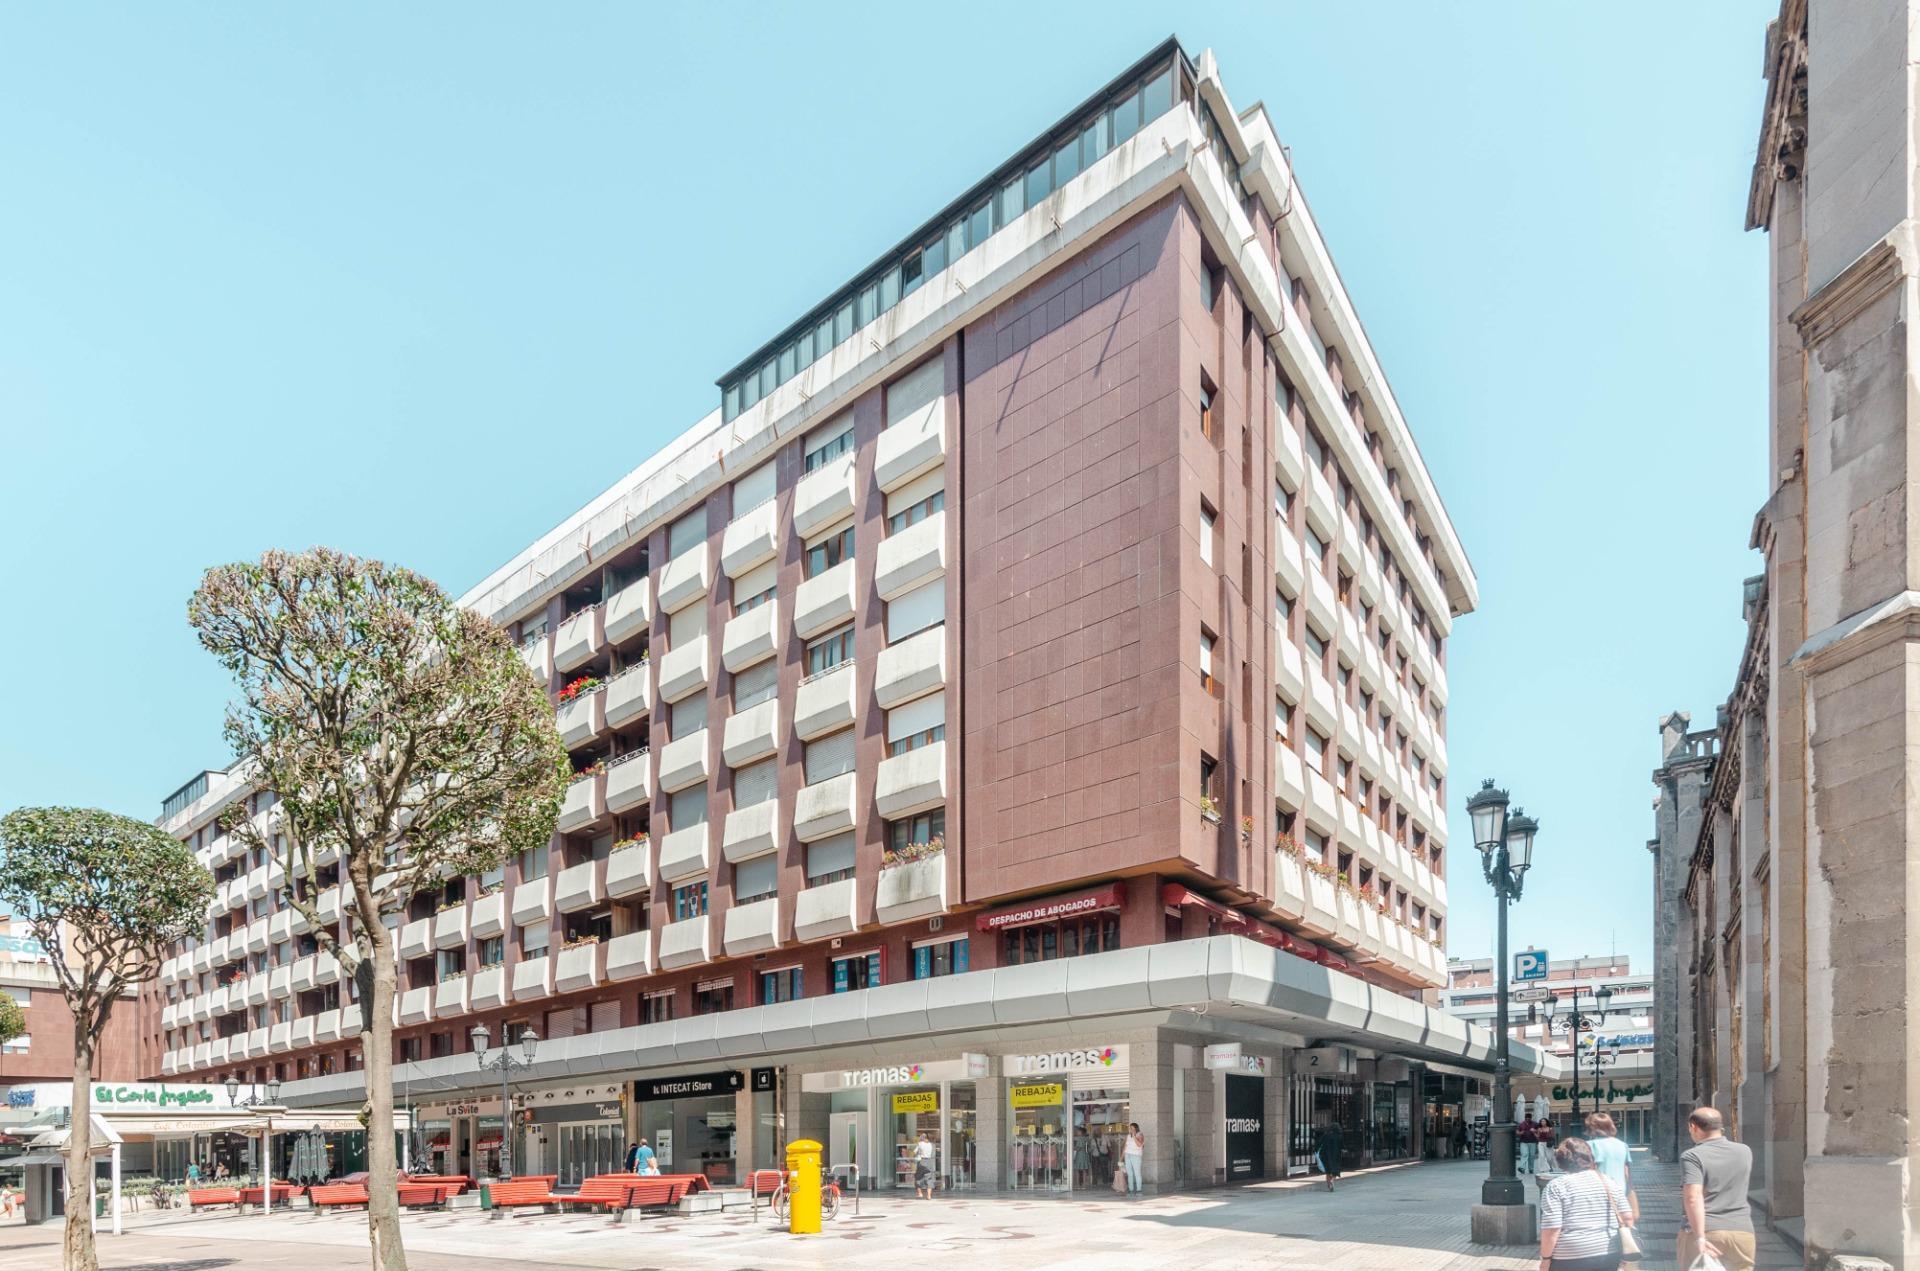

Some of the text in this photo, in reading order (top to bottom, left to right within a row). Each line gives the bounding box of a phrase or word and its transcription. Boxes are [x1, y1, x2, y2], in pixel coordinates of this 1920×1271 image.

[989, 898, 1097, 926] DESPACHO DE ABOGADOS
[1517, 955, 1538, 979] P
[1310, 1055, 1319, 1066] 2
[660, 1082, 690, 1094] INTECAT
[692, 1081, 712, 1091] iStore
[1015, 1086, 1057, 1097] REBAJAS
[96, 1086, 113, 1103] El
[115, 1086, 157, 1103] Corte
[897, 1094, 932, 1104] REBAJAS
[446, 1106, 457, 1116] La
